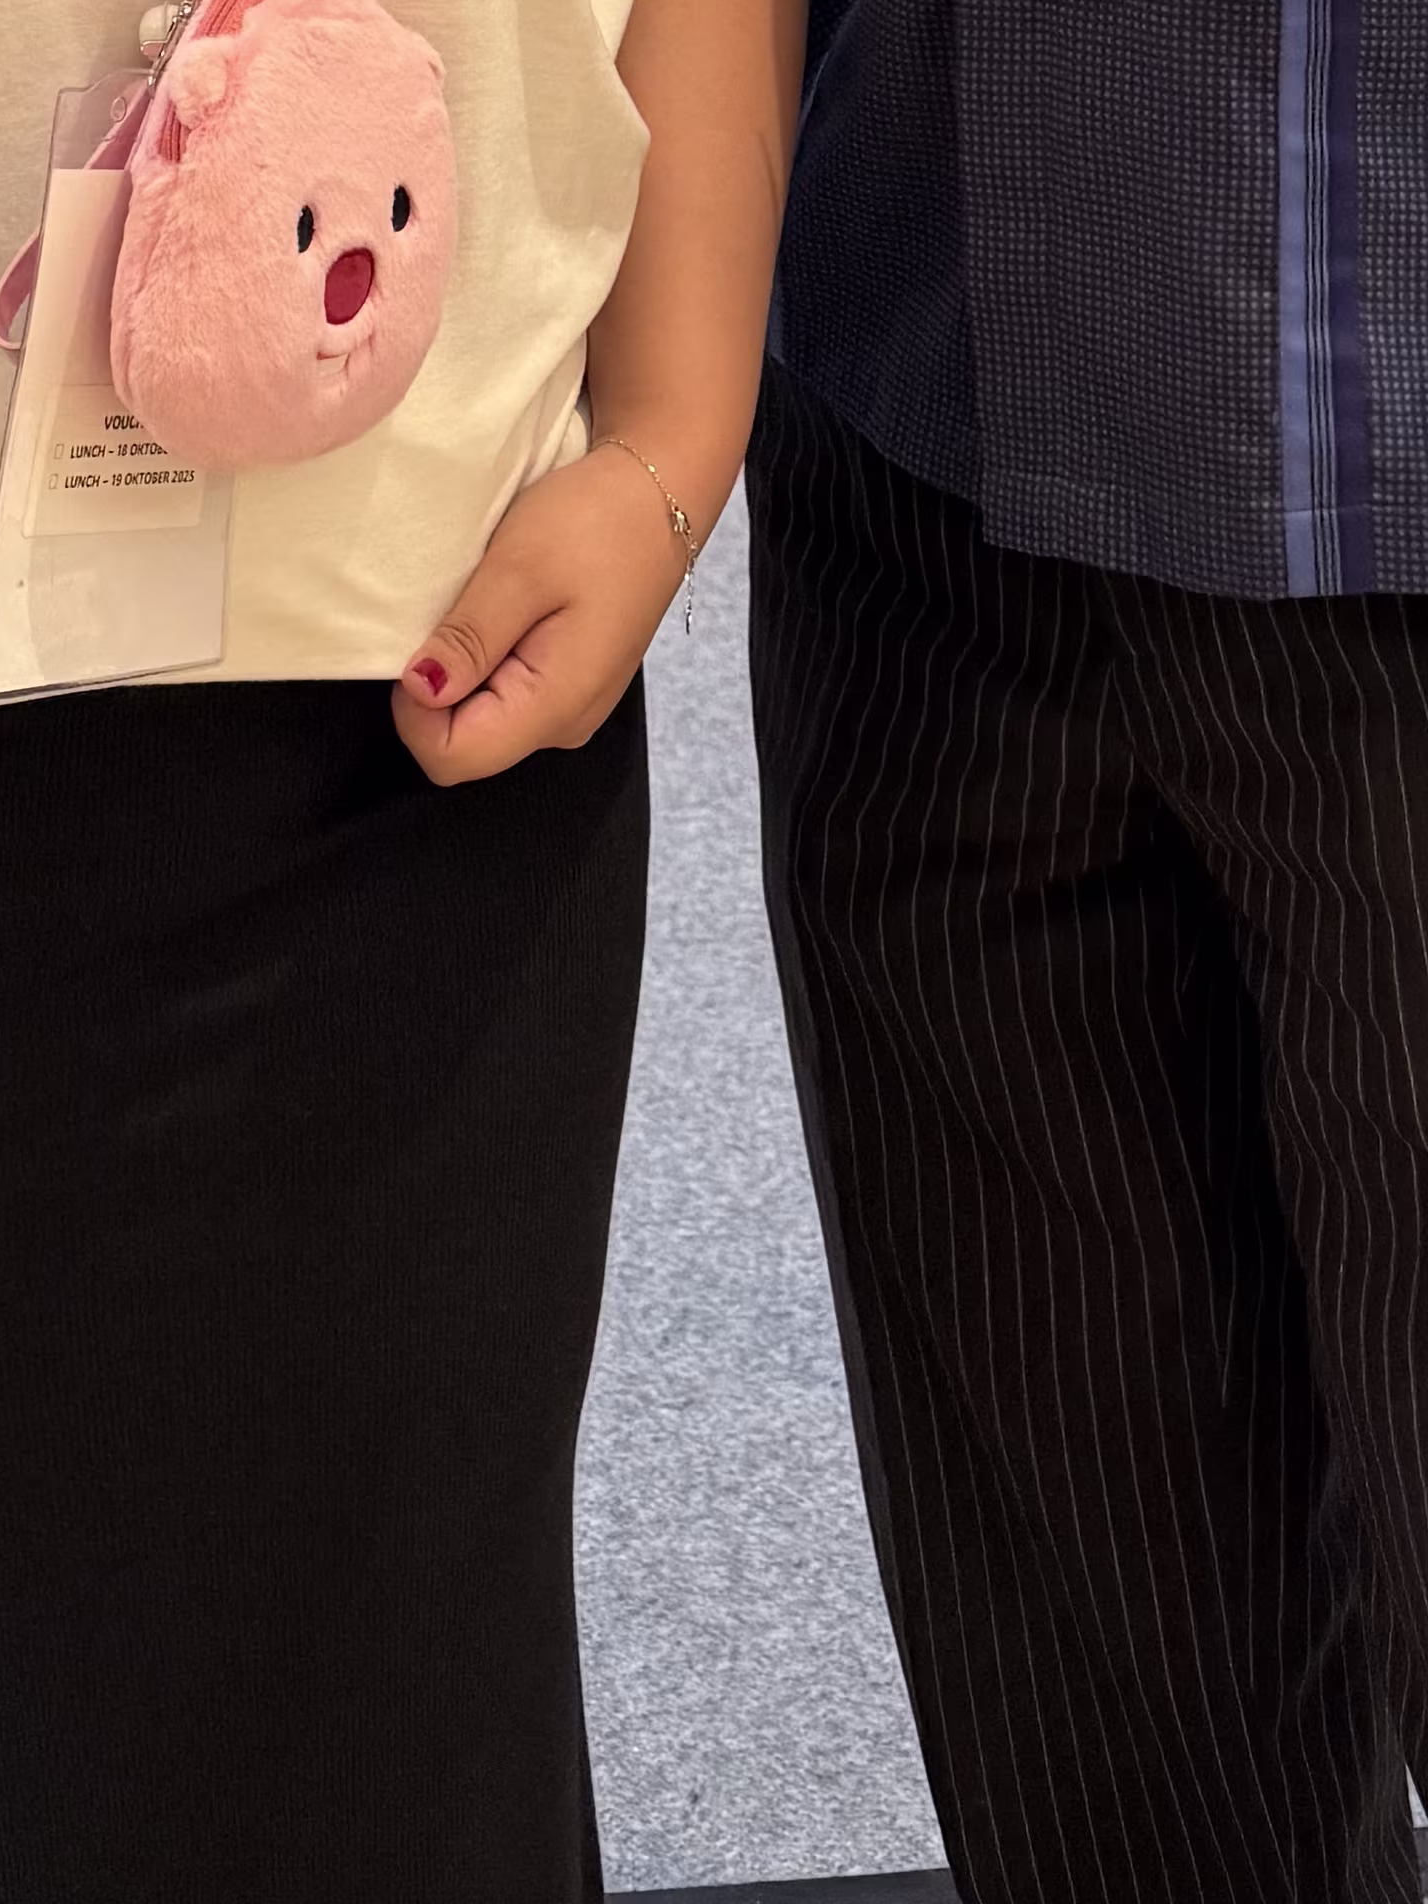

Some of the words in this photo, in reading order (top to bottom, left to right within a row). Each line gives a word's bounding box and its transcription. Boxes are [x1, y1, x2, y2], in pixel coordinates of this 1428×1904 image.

[70, 444, 107, 460] LUNCH
[117, 443, 128, 457] 18
[64, 474, 102, 489] LUNCH
[111, 472, 123, 487] 19
[124, 470, 170, 486] OKTOBER
[171, 469, 196, 484] 2025
